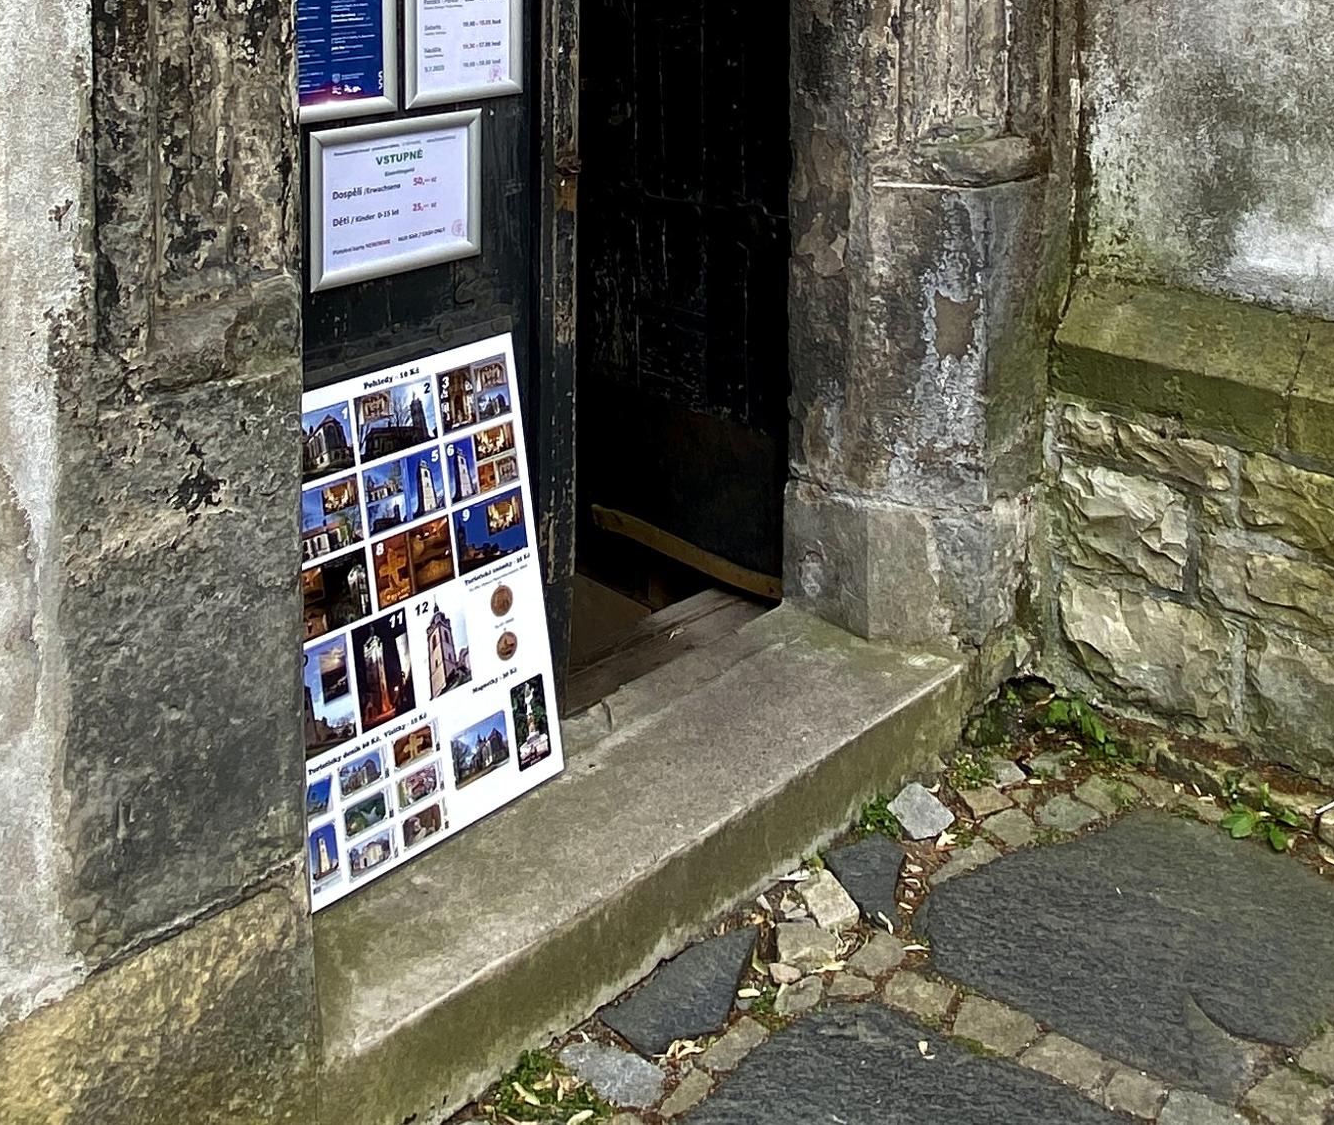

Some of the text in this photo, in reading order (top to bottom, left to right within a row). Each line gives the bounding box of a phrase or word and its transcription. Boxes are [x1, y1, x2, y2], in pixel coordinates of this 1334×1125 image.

[376, 149, 423, 166] VSTUPNÉ
[423, 382, 431, 395] 2
[442, 376, 450, 389] 3
[341, 408, 349, 420] 1
[431, 449, 439, 462] 5
[447, 443, 454, 456] 6
[462, 509, 470, 522] 9
[375, 542, 384, 556] 8
[414, 602, 429, 616] 12
[388, 612, 403, 629] 11
